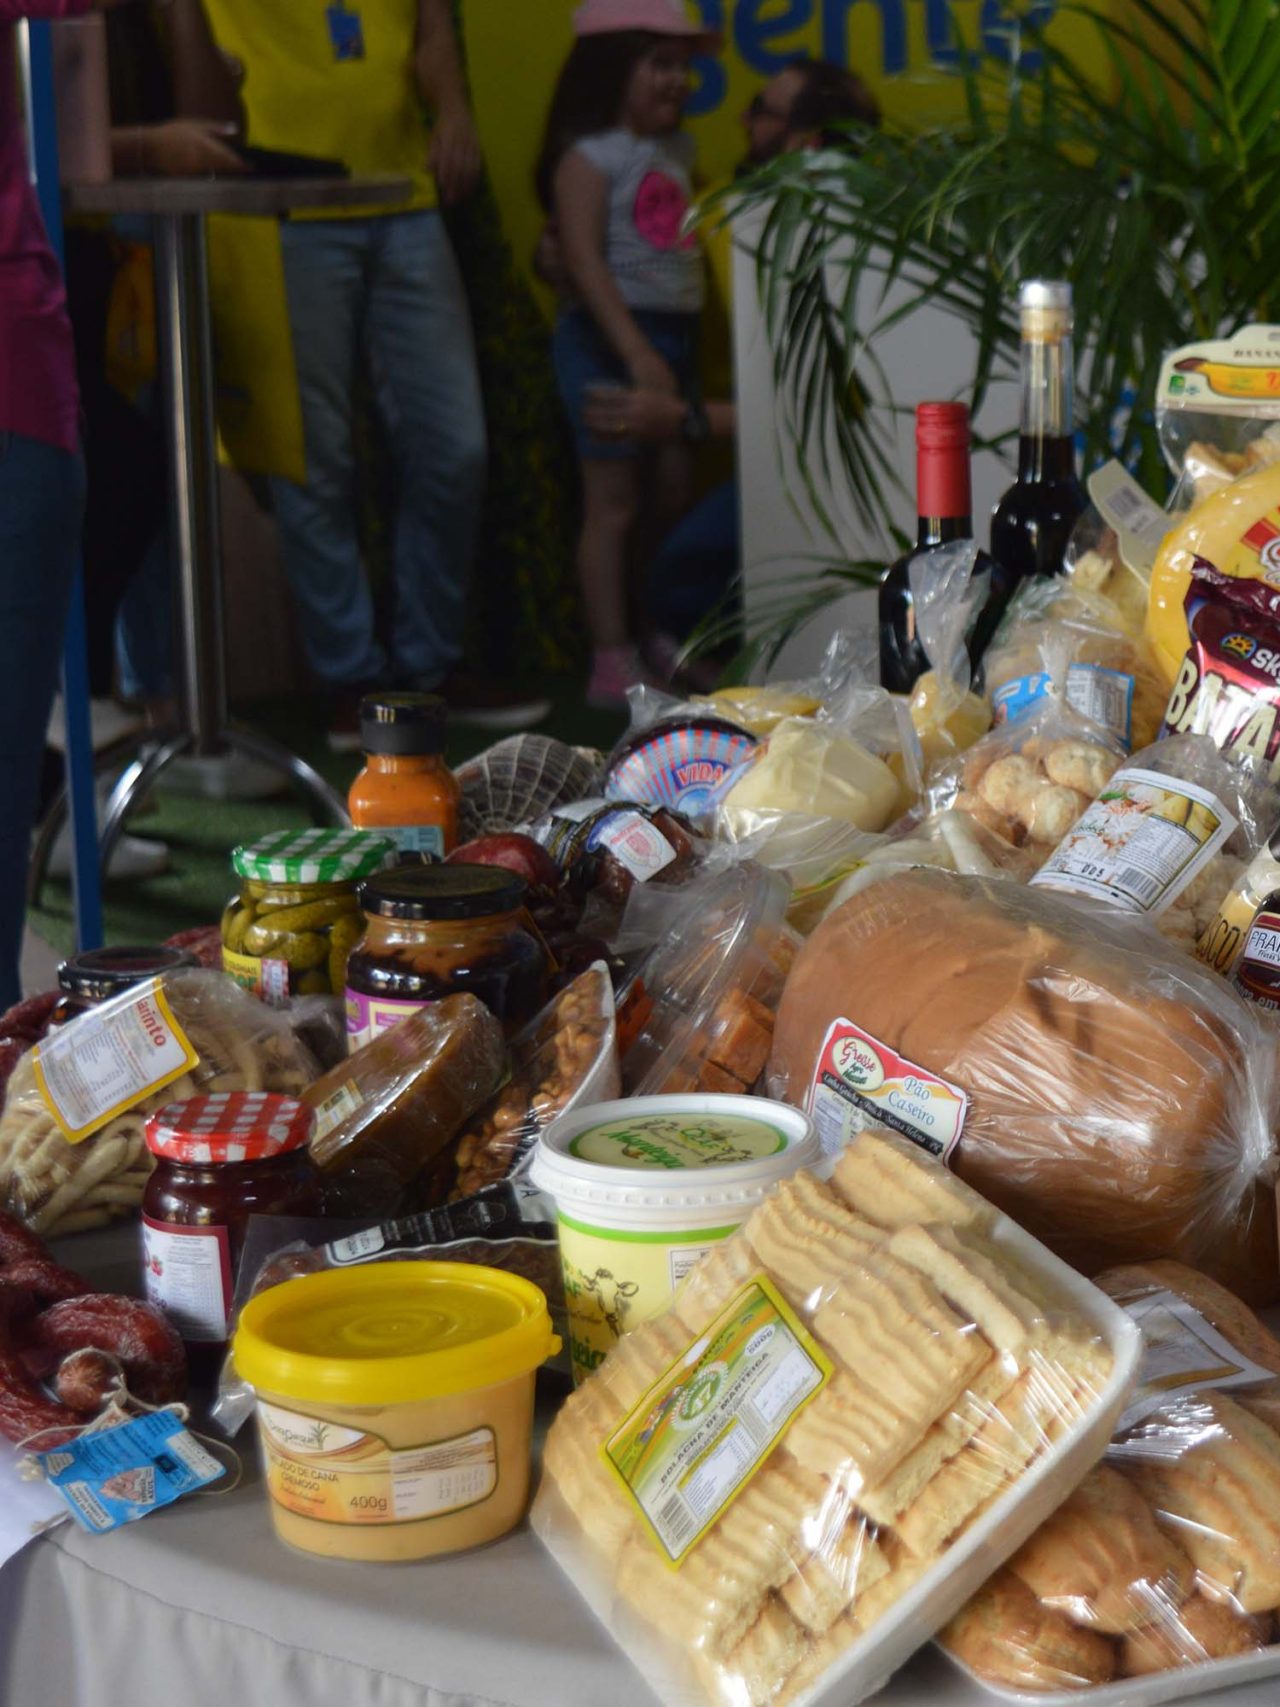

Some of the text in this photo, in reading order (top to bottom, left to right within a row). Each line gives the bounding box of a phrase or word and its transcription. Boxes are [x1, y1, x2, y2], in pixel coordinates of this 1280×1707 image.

[1257, 997, 1279, 1012] em
[904, 1076, 931, 1102] Pão
[888, 1089, 936, 1127] Caseiro
[659, 1430, 705, 1485] BOLACHA
[720, 1351, 771, 1410] MANTEIGA
[349, 1495, 388, 1512] 400g
